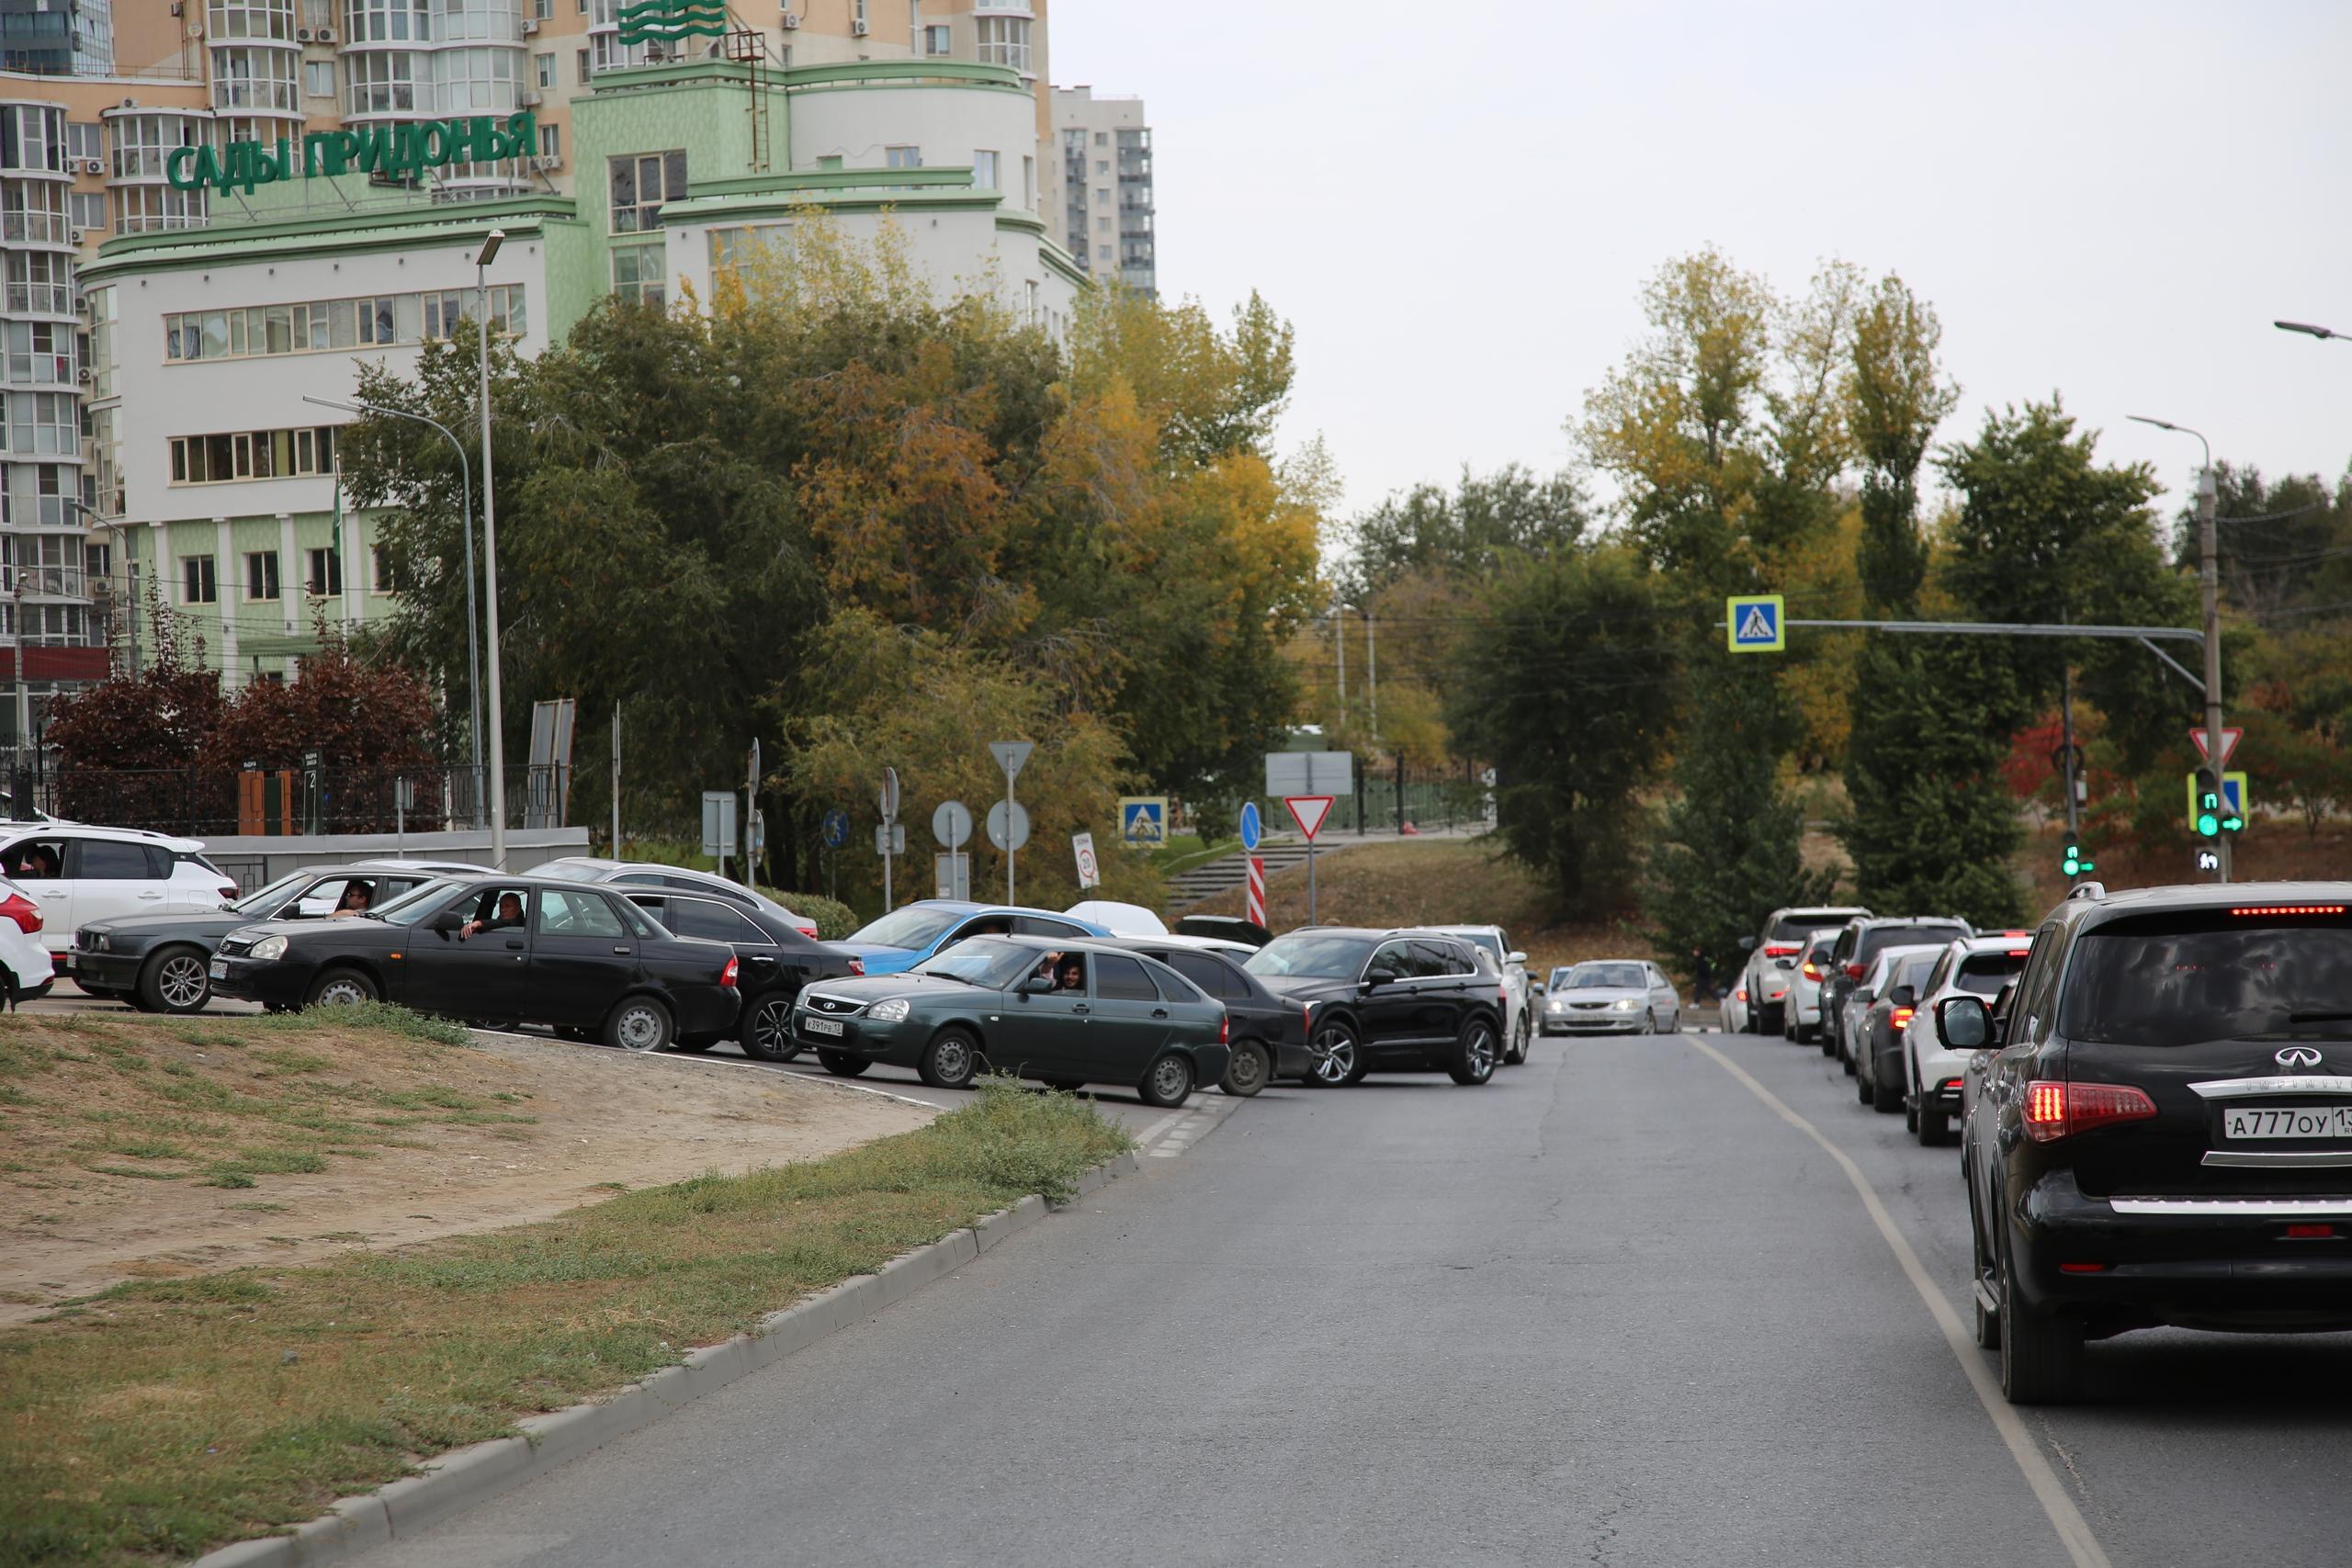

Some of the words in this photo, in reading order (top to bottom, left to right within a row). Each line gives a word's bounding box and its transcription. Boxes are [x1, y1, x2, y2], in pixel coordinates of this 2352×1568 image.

[167, 138, 290, 197] САДЫ
[304, 112, 537, 181] ПРИДОНЬЯ
[310, 773, 316, 788] 2
